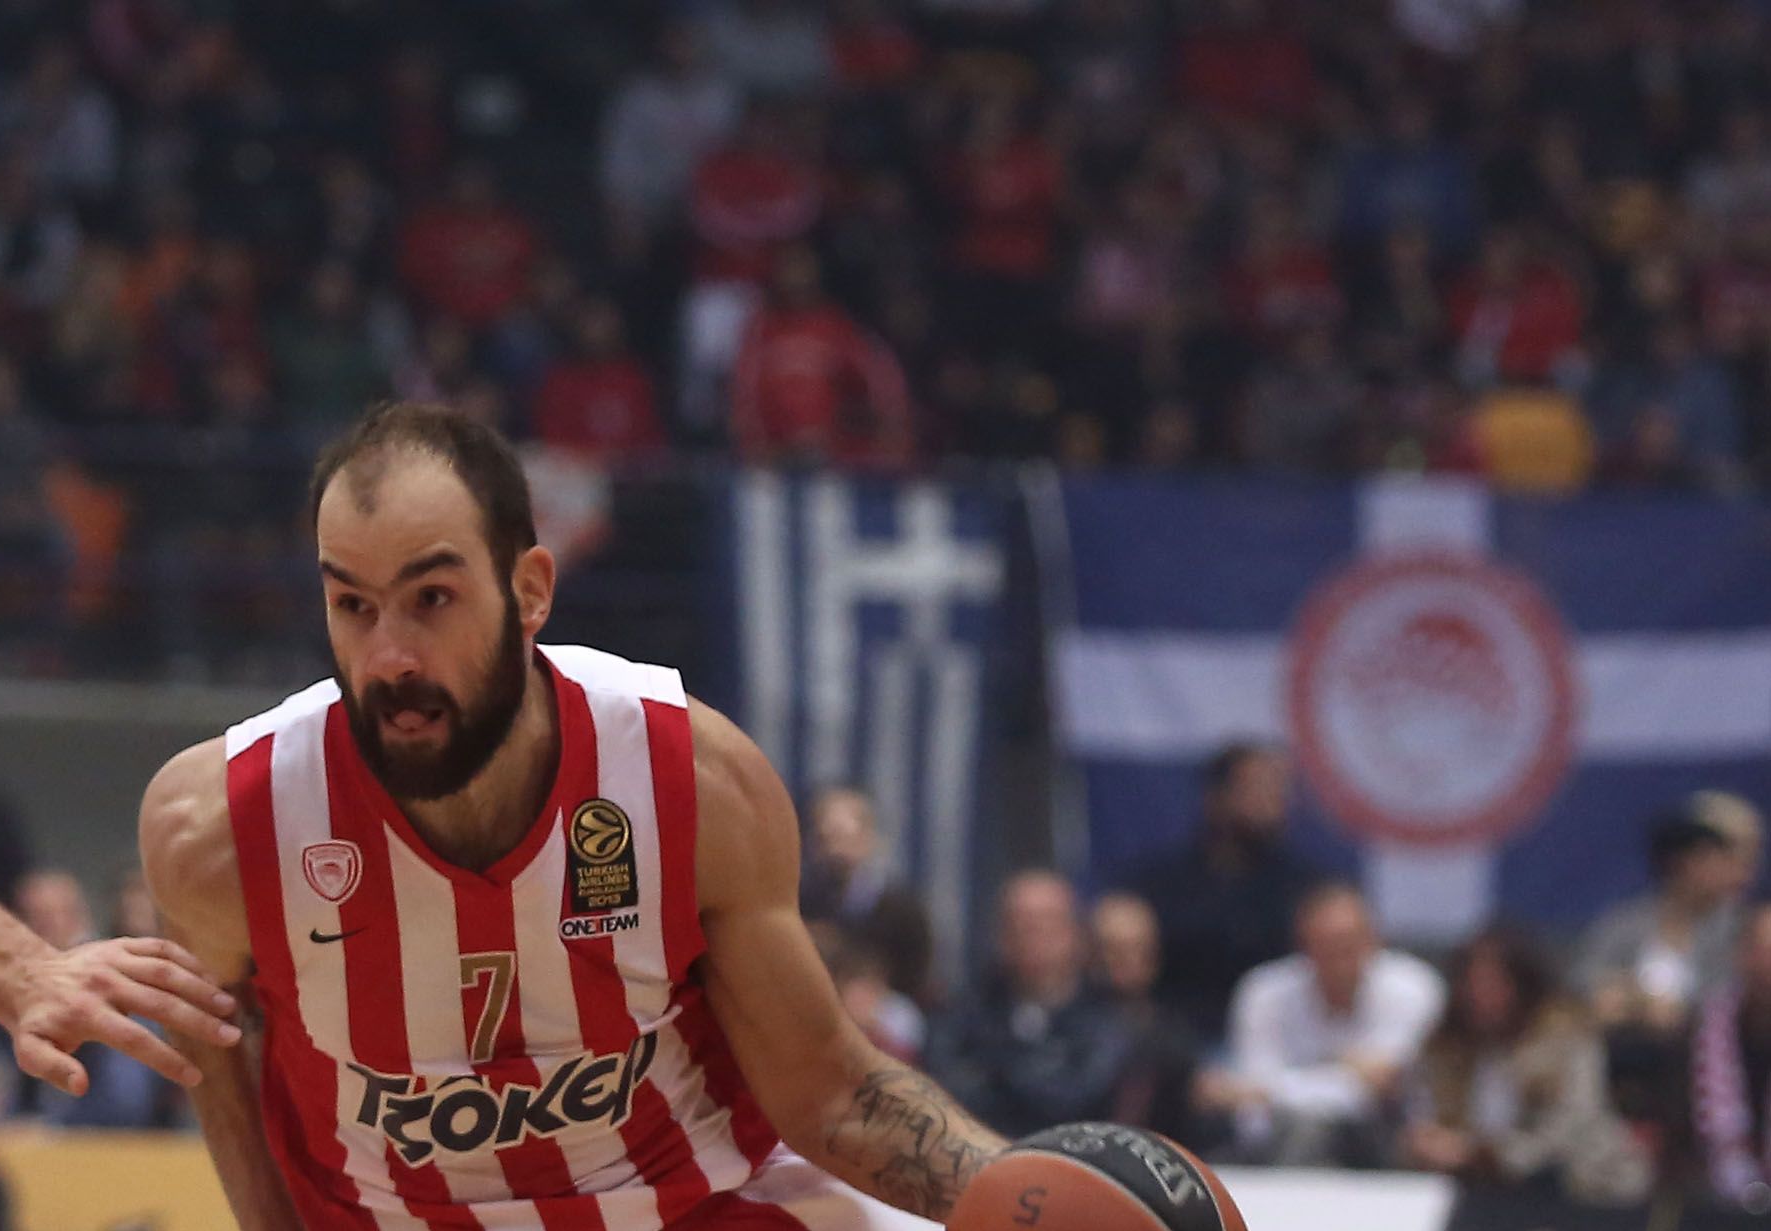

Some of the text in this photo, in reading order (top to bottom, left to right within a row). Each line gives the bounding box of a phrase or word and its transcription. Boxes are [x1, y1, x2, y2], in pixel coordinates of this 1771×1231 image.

[577, 863, 629, 877] TURKISH
[460, 952, 516, 1063] 7
[1012, 1187, 1049, 1227] 5
